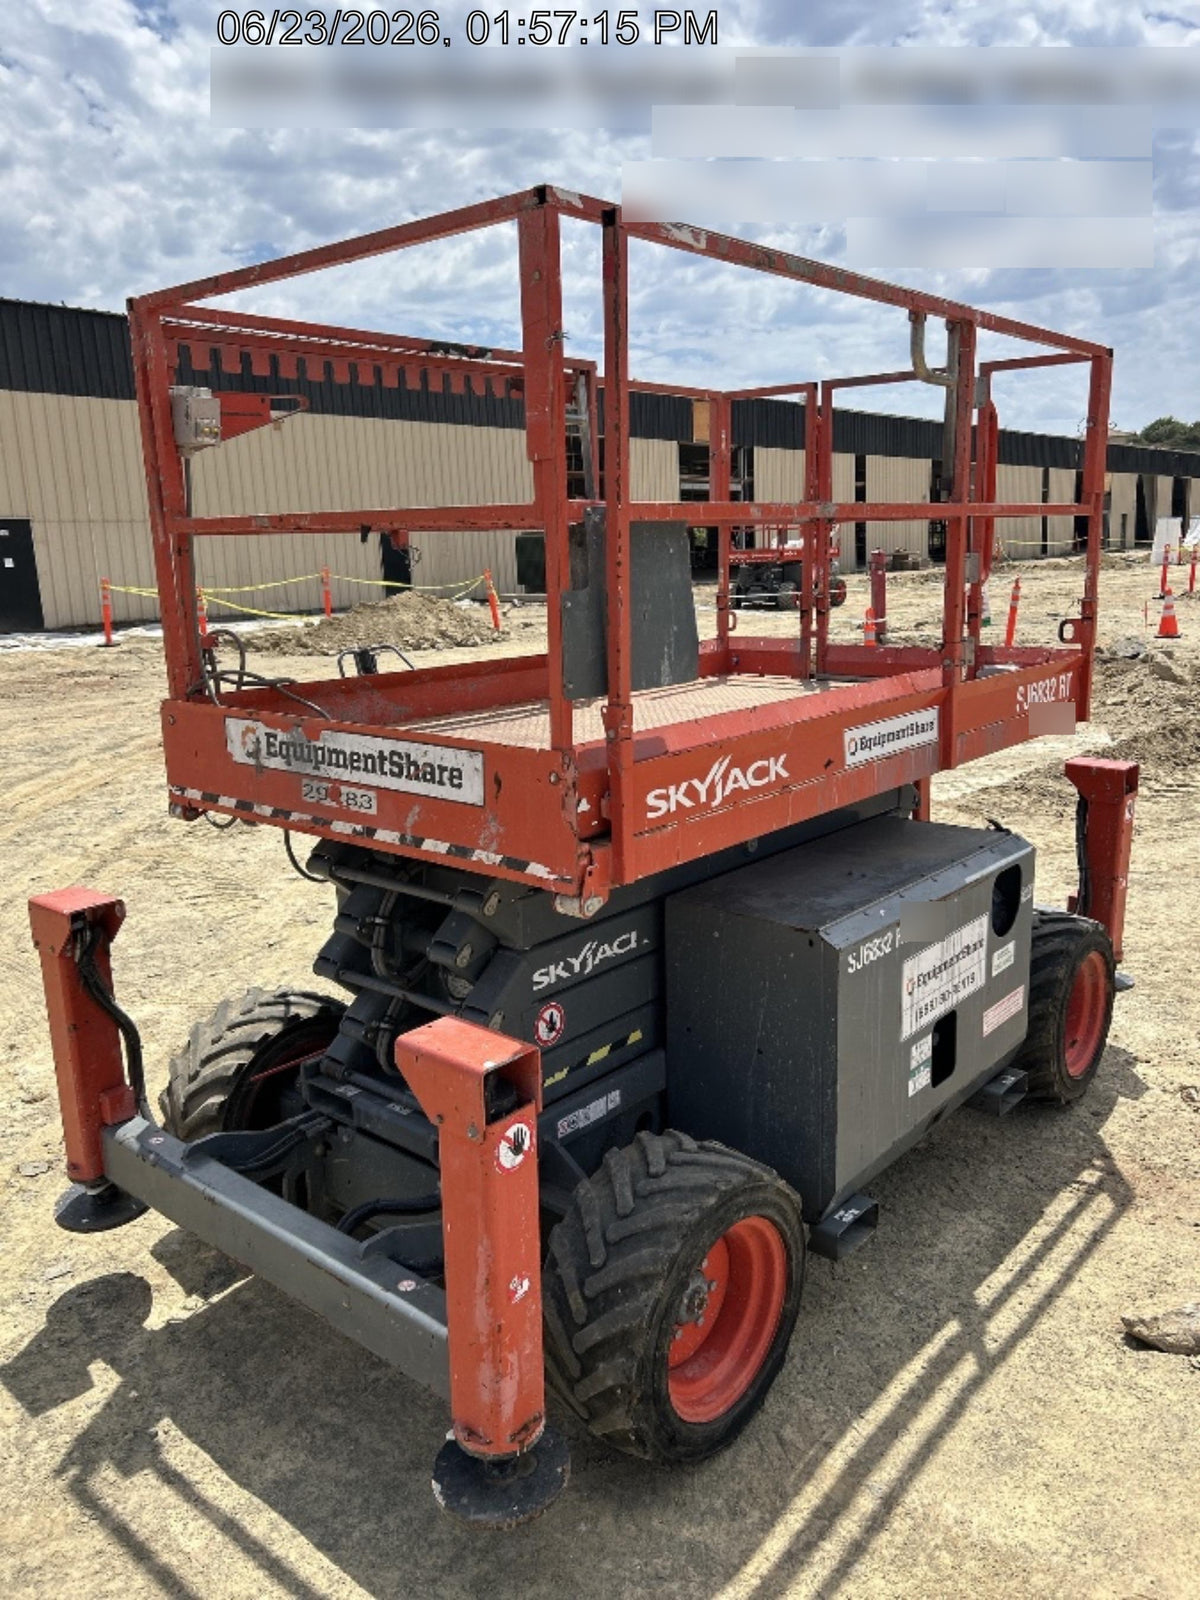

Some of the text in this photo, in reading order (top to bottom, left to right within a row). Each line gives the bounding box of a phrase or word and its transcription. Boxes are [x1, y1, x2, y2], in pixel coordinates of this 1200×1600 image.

[859, 721, 935, 751] EquipmentShare
[264, 732, 464, 790] EquipmentShare
[303, 783, 373, 810] 2983
[646, 753, 790, 819] SKYJACK
